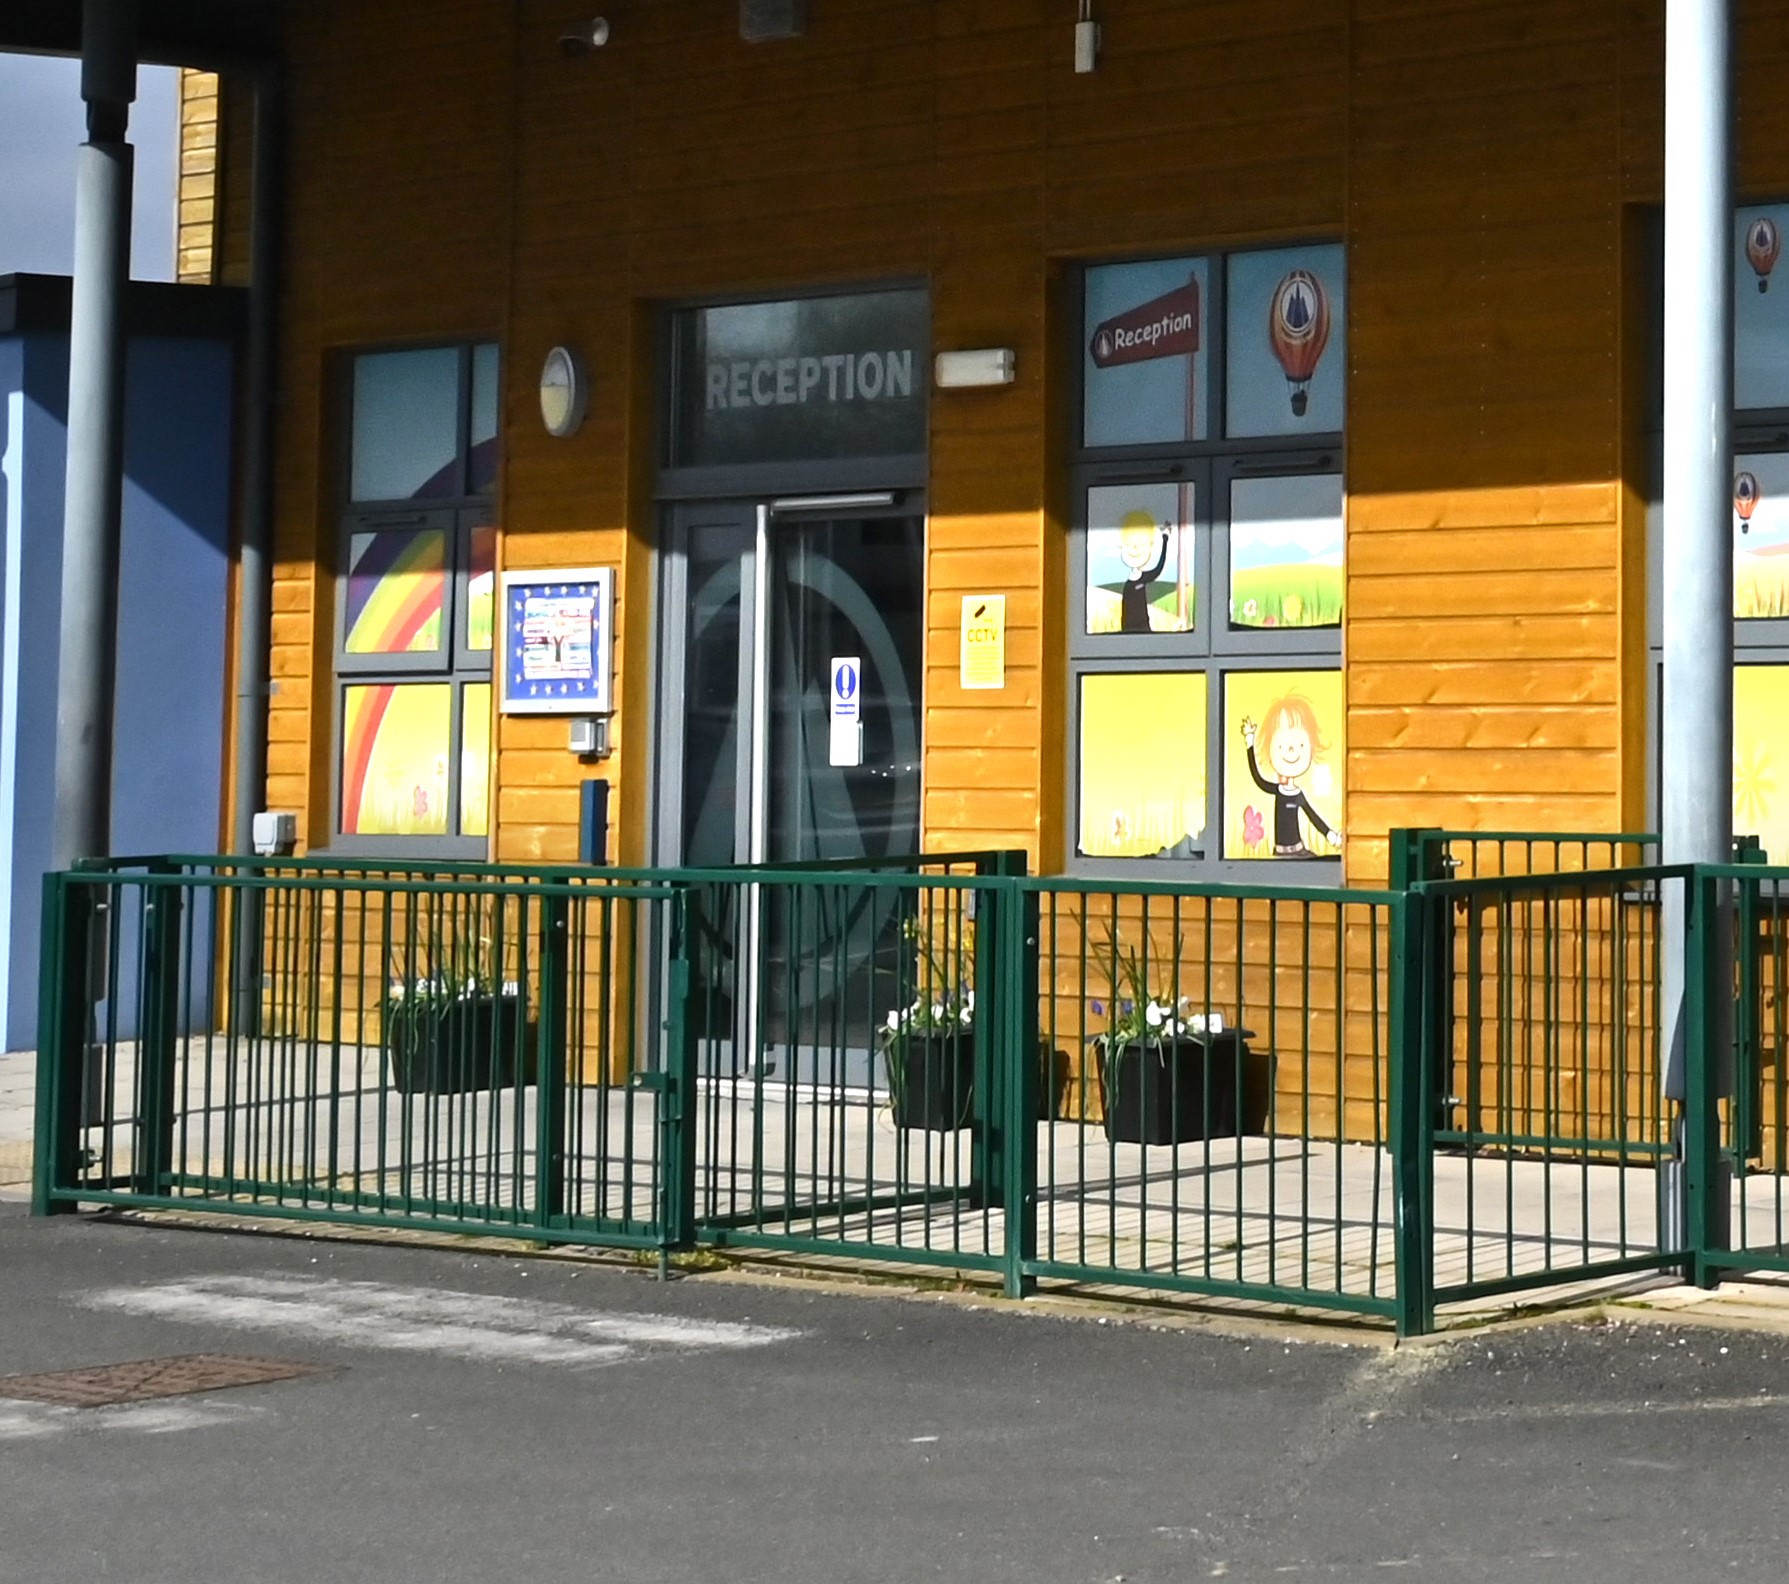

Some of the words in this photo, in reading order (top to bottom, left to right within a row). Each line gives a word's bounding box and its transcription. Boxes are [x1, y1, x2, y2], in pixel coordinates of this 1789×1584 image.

[1115, 312, 1191, 351] Reception
[706, 350, 912, 409] RECEPTION
[967, 629, 997, 642] CCTV
